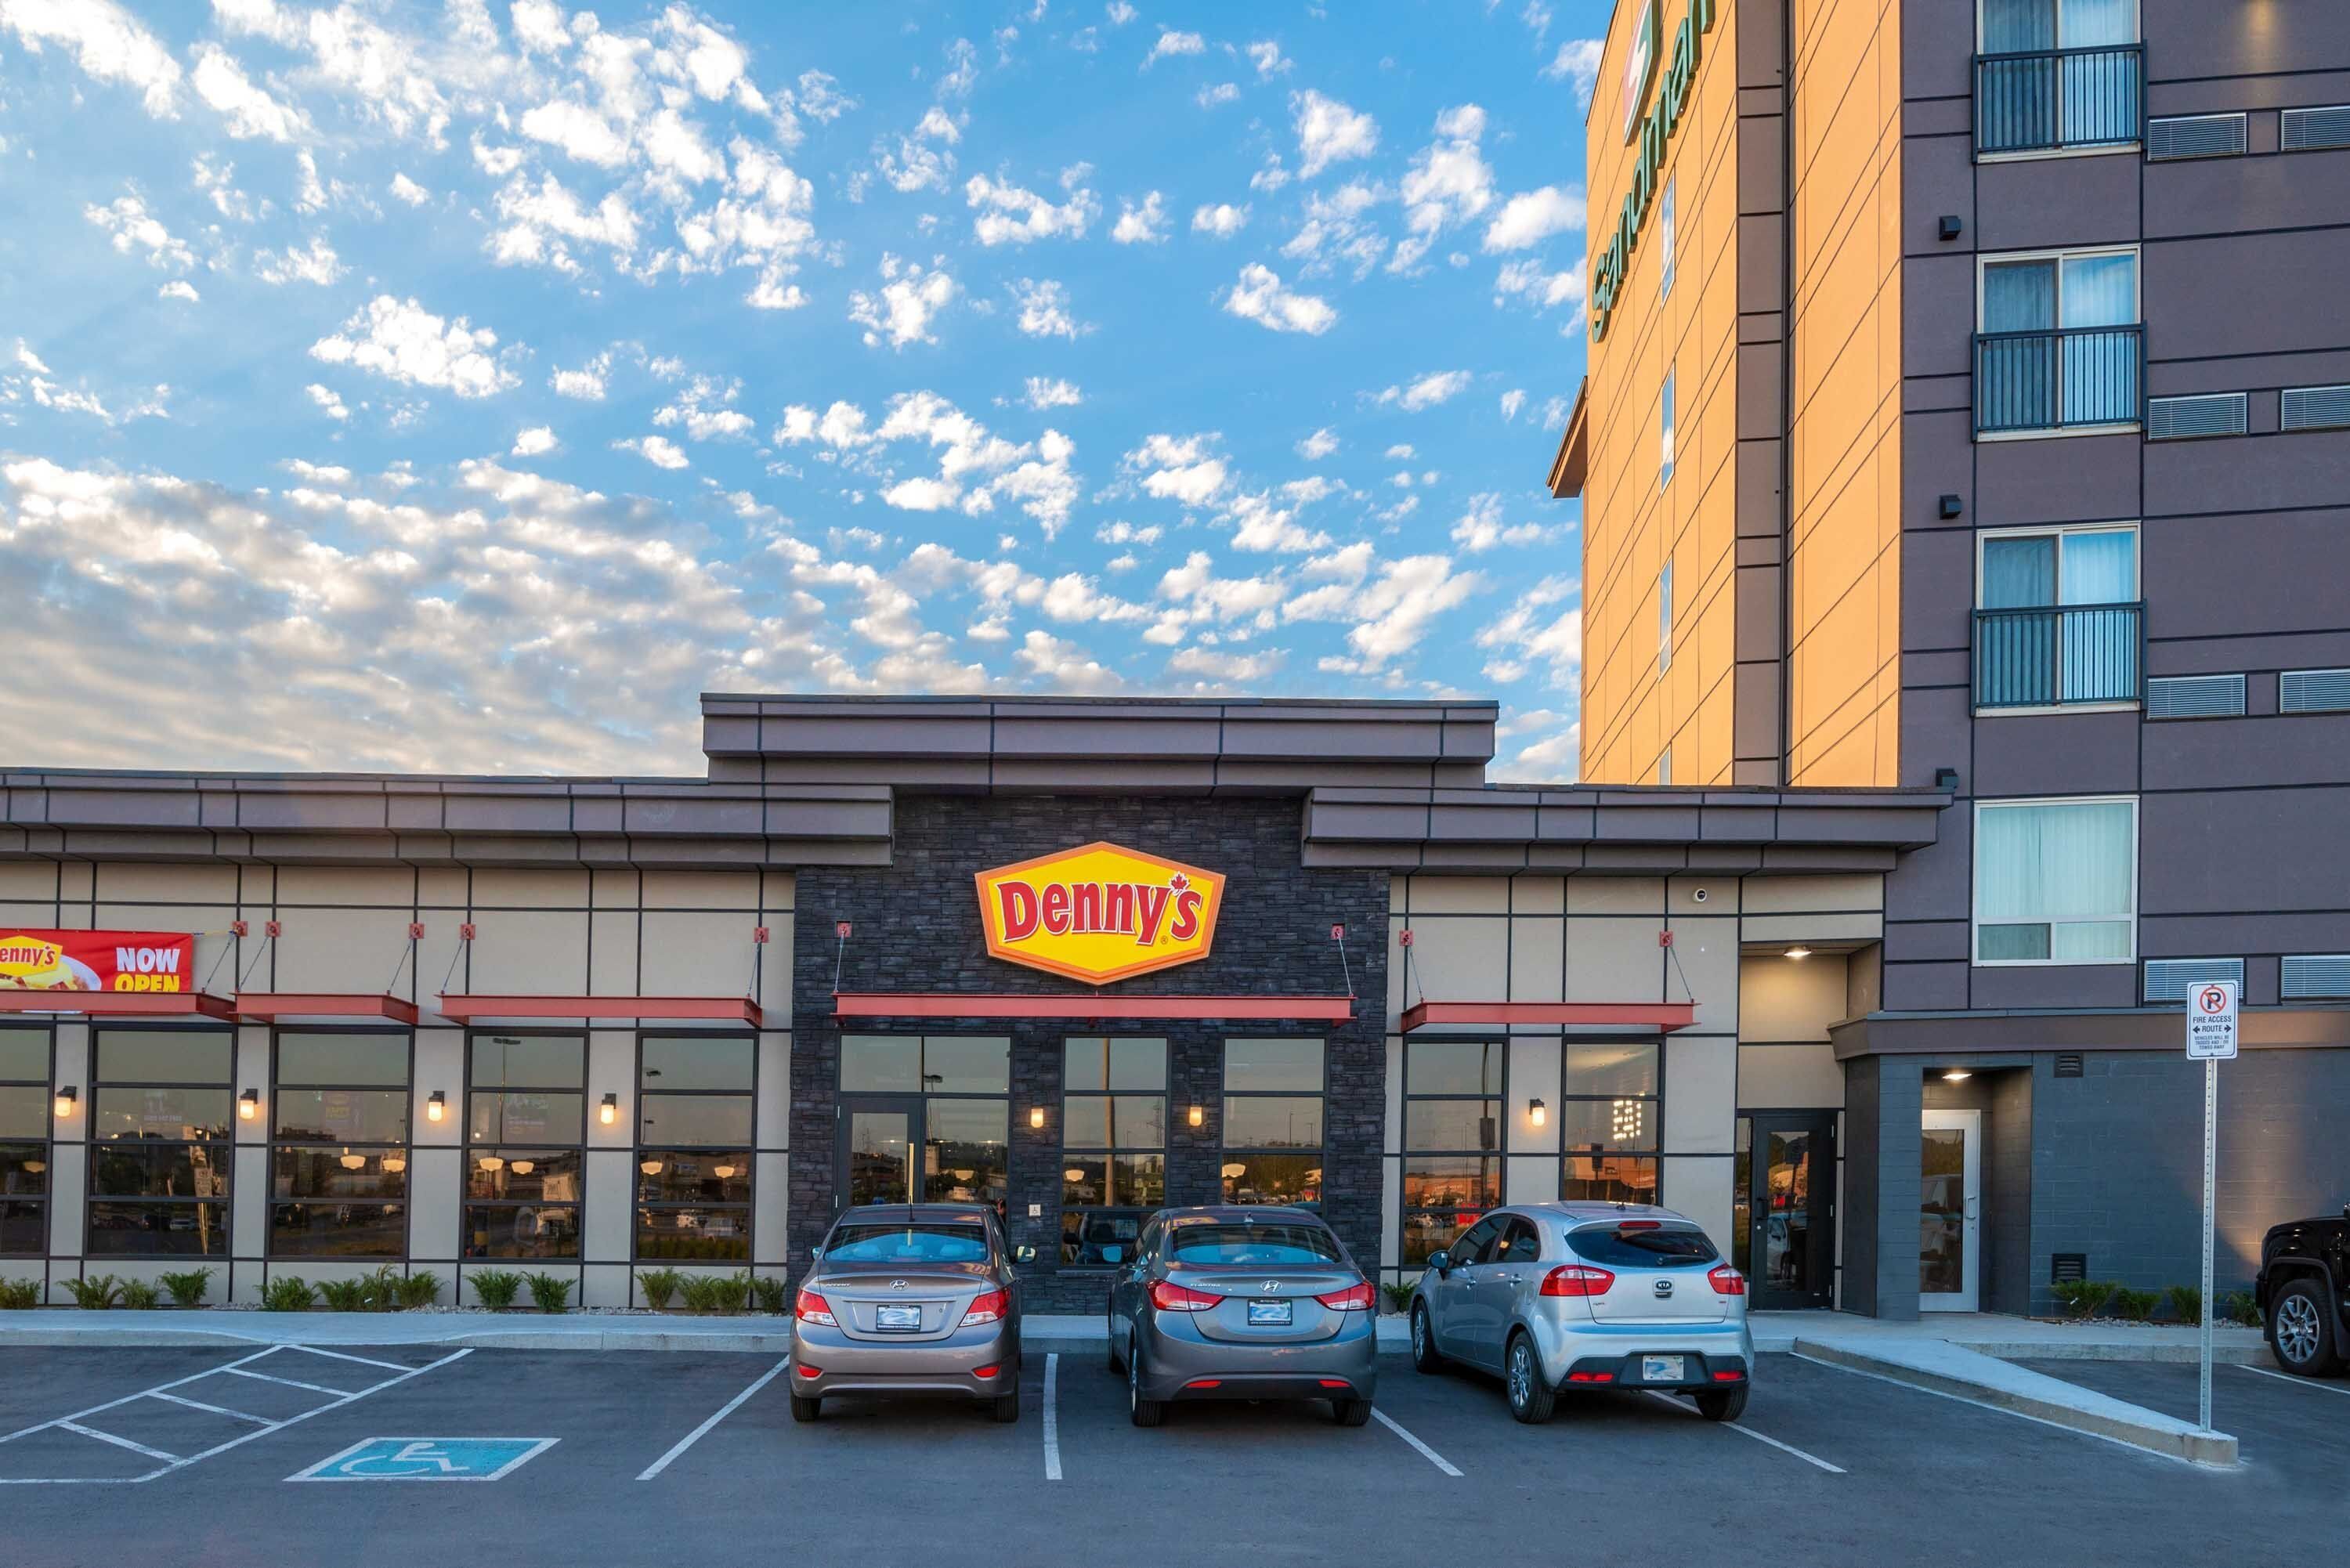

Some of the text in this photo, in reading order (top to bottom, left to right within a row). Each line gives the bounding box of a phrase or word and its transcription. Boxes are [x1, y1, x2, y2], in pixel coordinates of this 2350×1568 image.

[996, 872, 1203, 946] Denny's
[116, 947, 181, 973] NOW
[114, 974, 180, 992] OPEN
